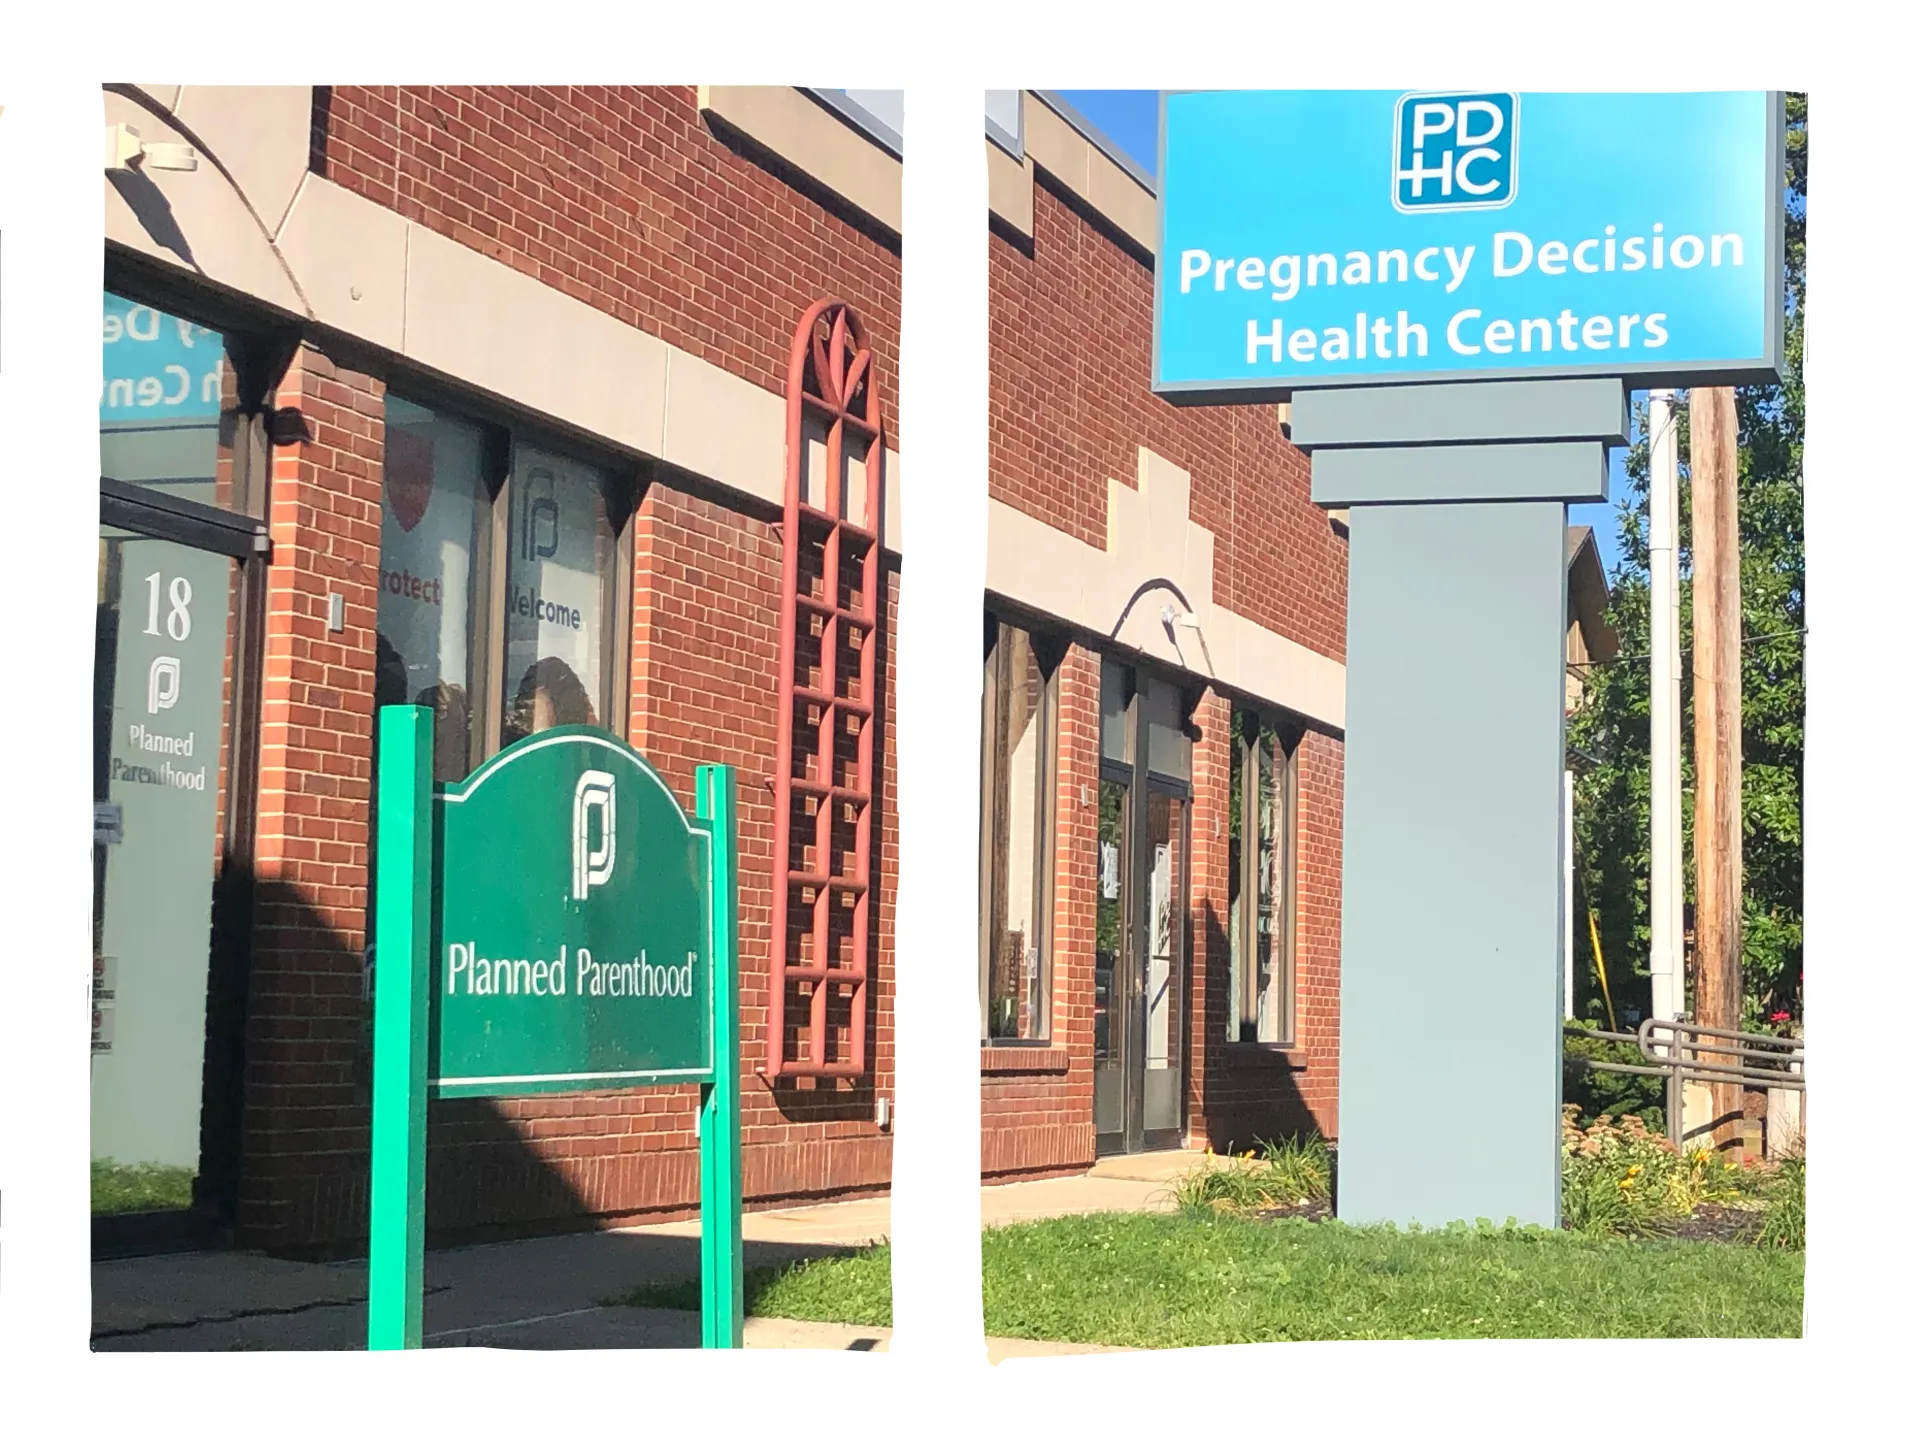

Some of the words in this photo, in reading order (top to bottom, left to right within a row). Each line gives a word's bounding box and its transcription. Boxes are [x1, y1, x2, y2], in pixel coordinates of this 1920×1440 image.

[1413, 100, 1504, 149] PD
[1180, 243, 1476, 301] Pregnancy
[1492, 223, 1744, 278] Decision
[1246, 310, 1428, 364] Health
[1446, 309, 1669, 356] Centers
[142, 571, 193, 641] 18
[380, 568, 440, 606] rotect
[129, 724, 194, 757] Planned
[111, 757, 206, 791] Parenthood
[447, 941, 567, 997] Planned
